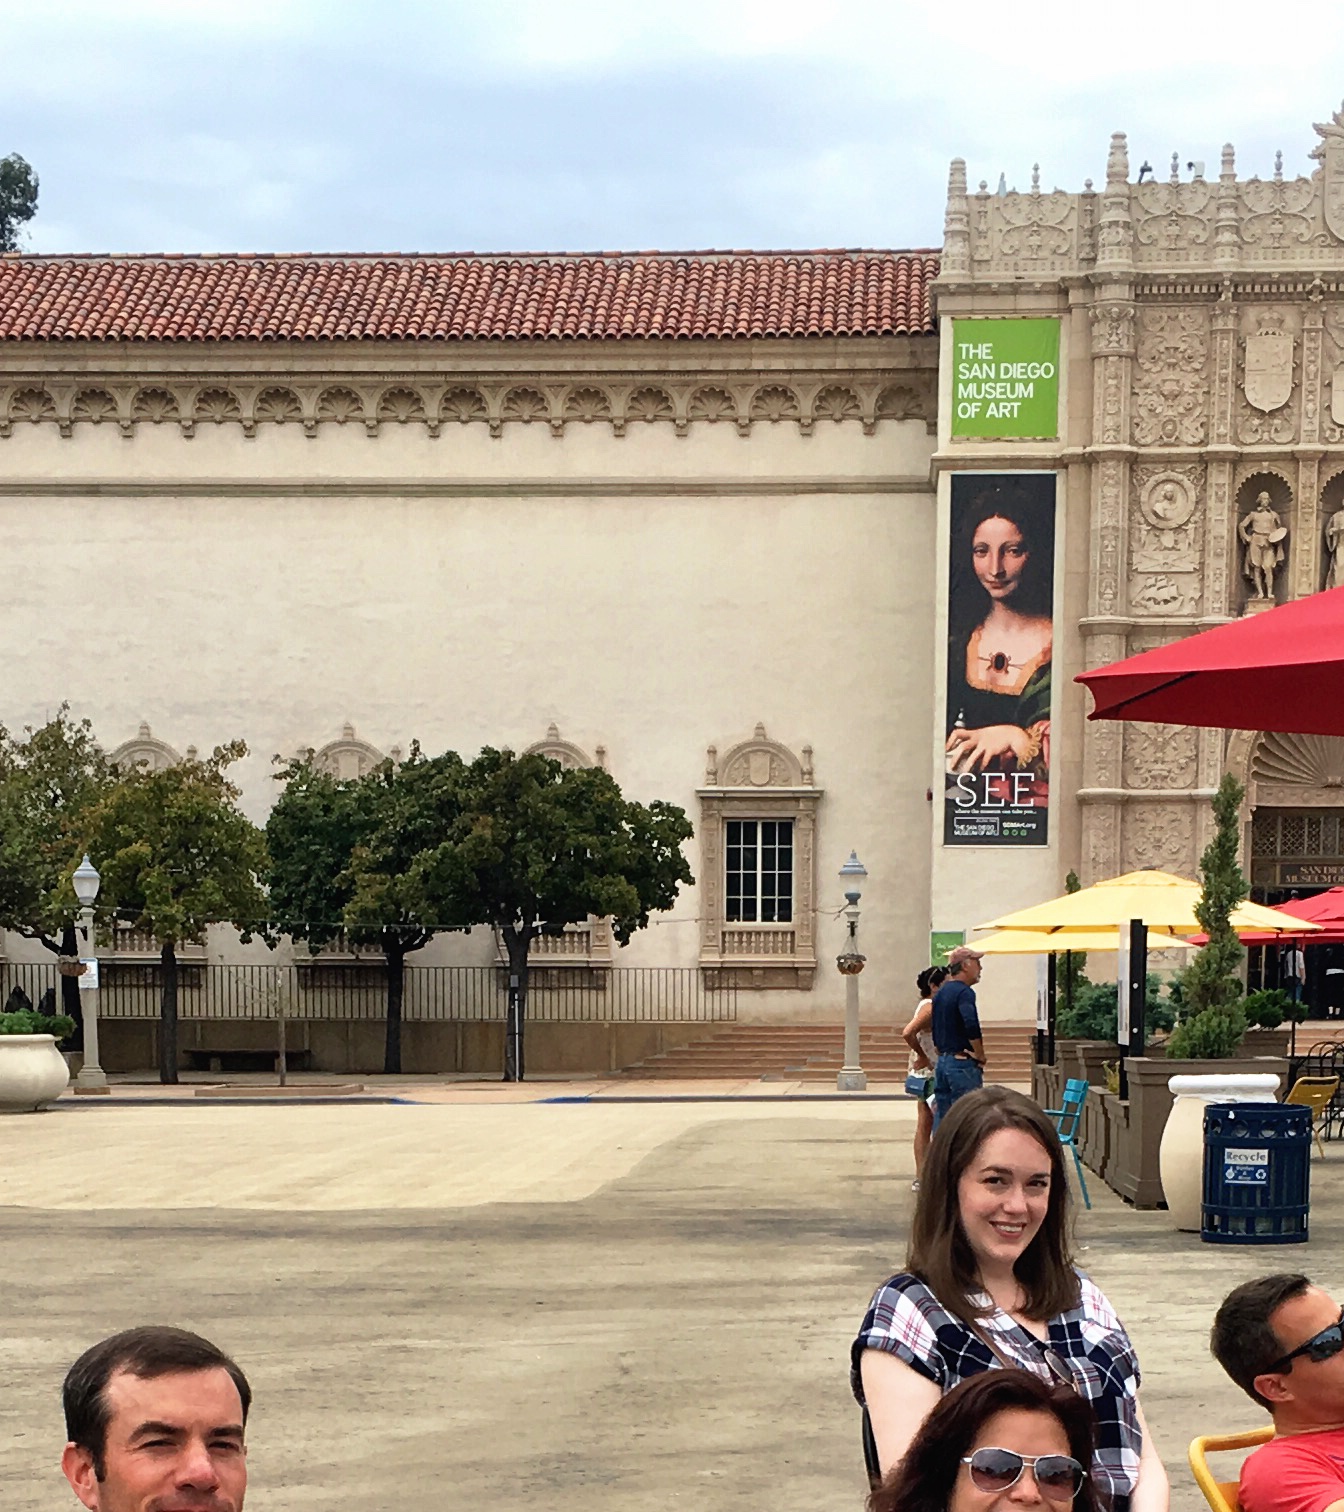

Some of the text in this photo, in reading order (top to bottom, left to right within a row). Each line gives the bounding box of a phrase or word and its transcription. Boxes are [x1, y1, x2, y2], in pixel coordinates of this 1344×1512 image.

[958, 343, 993, 360] THE
[958, 362, 1054, 380] SAN DIEGO
[958, 382, 1034, 399] MUSEUM
[958, 402, 1021, 419] OF ART
[955, 772, 1035, 807] SEE
[1226, 1151, 1266, 1162] Recycle
